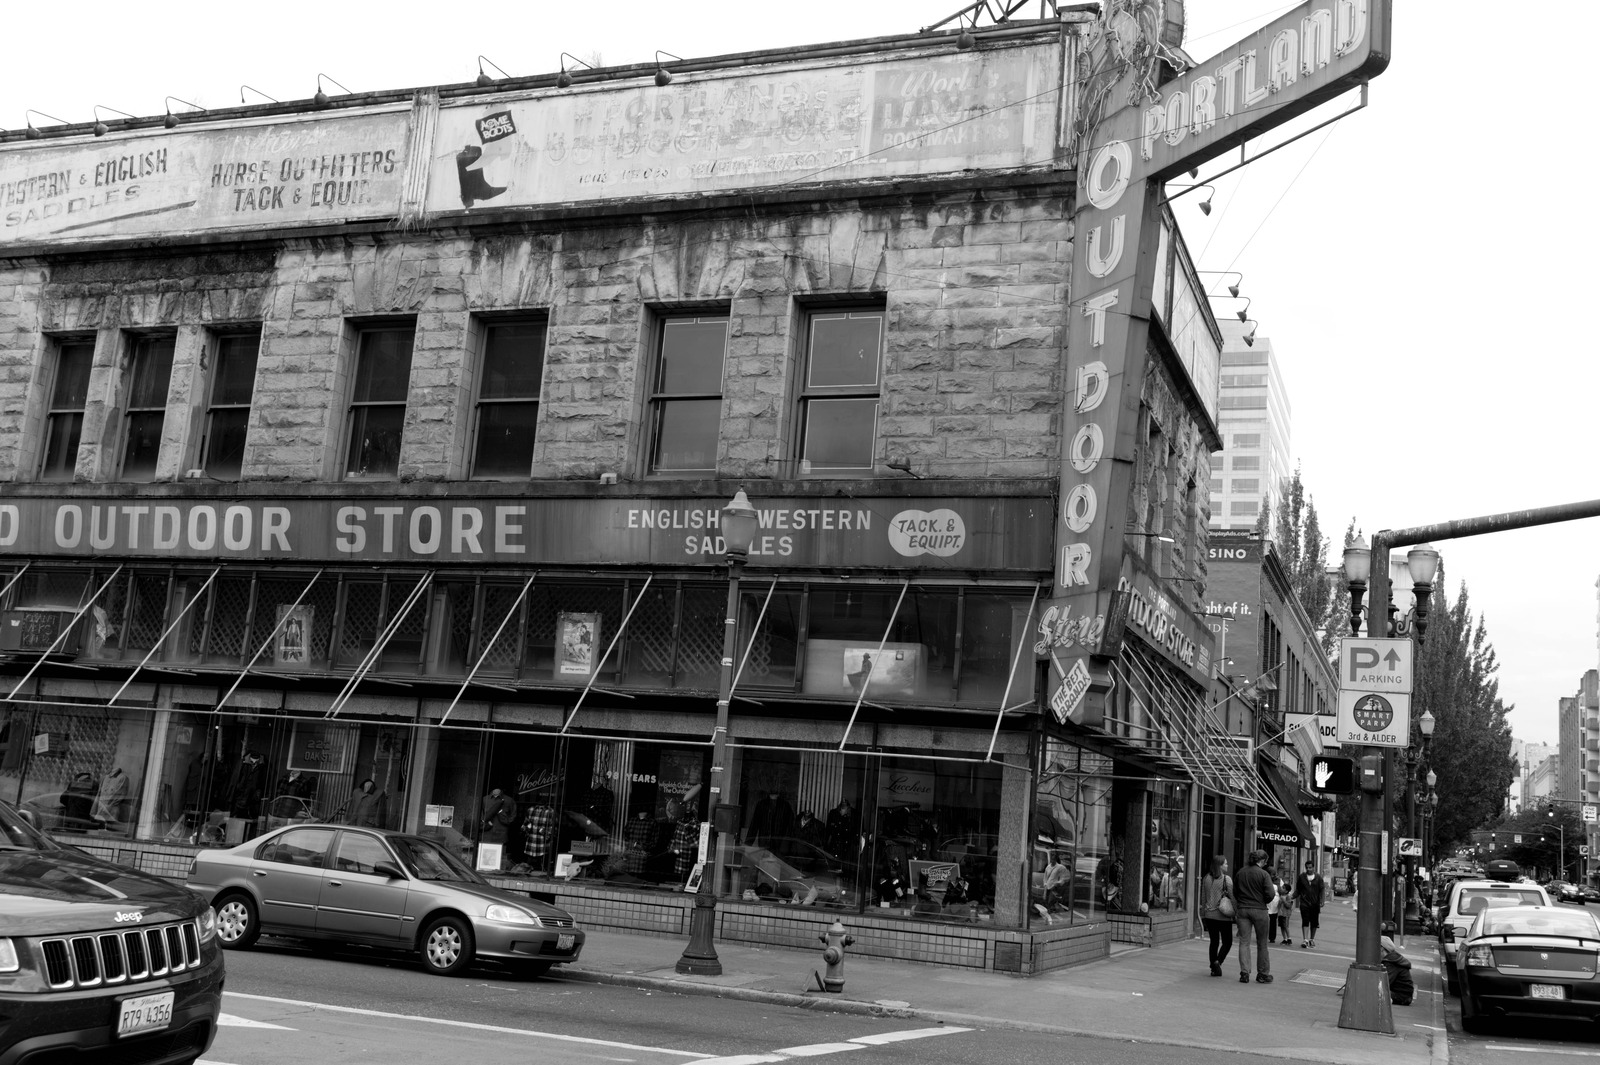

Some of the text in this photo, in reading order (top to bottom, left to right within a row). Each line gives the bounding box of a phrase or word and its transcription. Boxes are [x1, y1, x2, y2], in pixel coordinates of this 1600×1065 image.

[1140, 0, 1367, 161] PORTLAND
[481, 114, 510, 131] ACME
[482, 123, 514, 139] BOOTS
[79, 173, 87, 186] &
[95, 147, 168, 187] ENGLISH
[211, 160, 271, 188] HORSE
[6, 185, 141, 227] SADDLES
[233, 186, 286, 211] TACK
[293, 187, 302, 204] &
[1060, 140, 1132, 588] OUTDOOR
[54, 504, 292, 551] OUTDOOR
[335, 505, 527, 554] STORE
[628, 509, 871, 530] ENGLISH WESTERN
[898, 518, 955, 533] TACK. &
[685, 536, 793, 555] SADLES
[909, 534, 961, 550] EQUIPT.
[1034, 604, 1105, 655] Store
[1167, 624, 1196, 668] STORE
[1054, 663, 1083, 708] THE BEST
[1357, 711, 1390, 720] SMART
[1361, 719, 1386, 727] PARK
[1348, 732, 1361, 741] 3rd
[1371, 734, 1397, 743] ALDER
[304, 751, 320, 761] OAK
[626, 773, 657, 784] YEARS
[882, 775, 931, 794] Lucchese
[114, 911, 143, 922] Jeep
[122, 1003, 171, 1029] R79 4356
